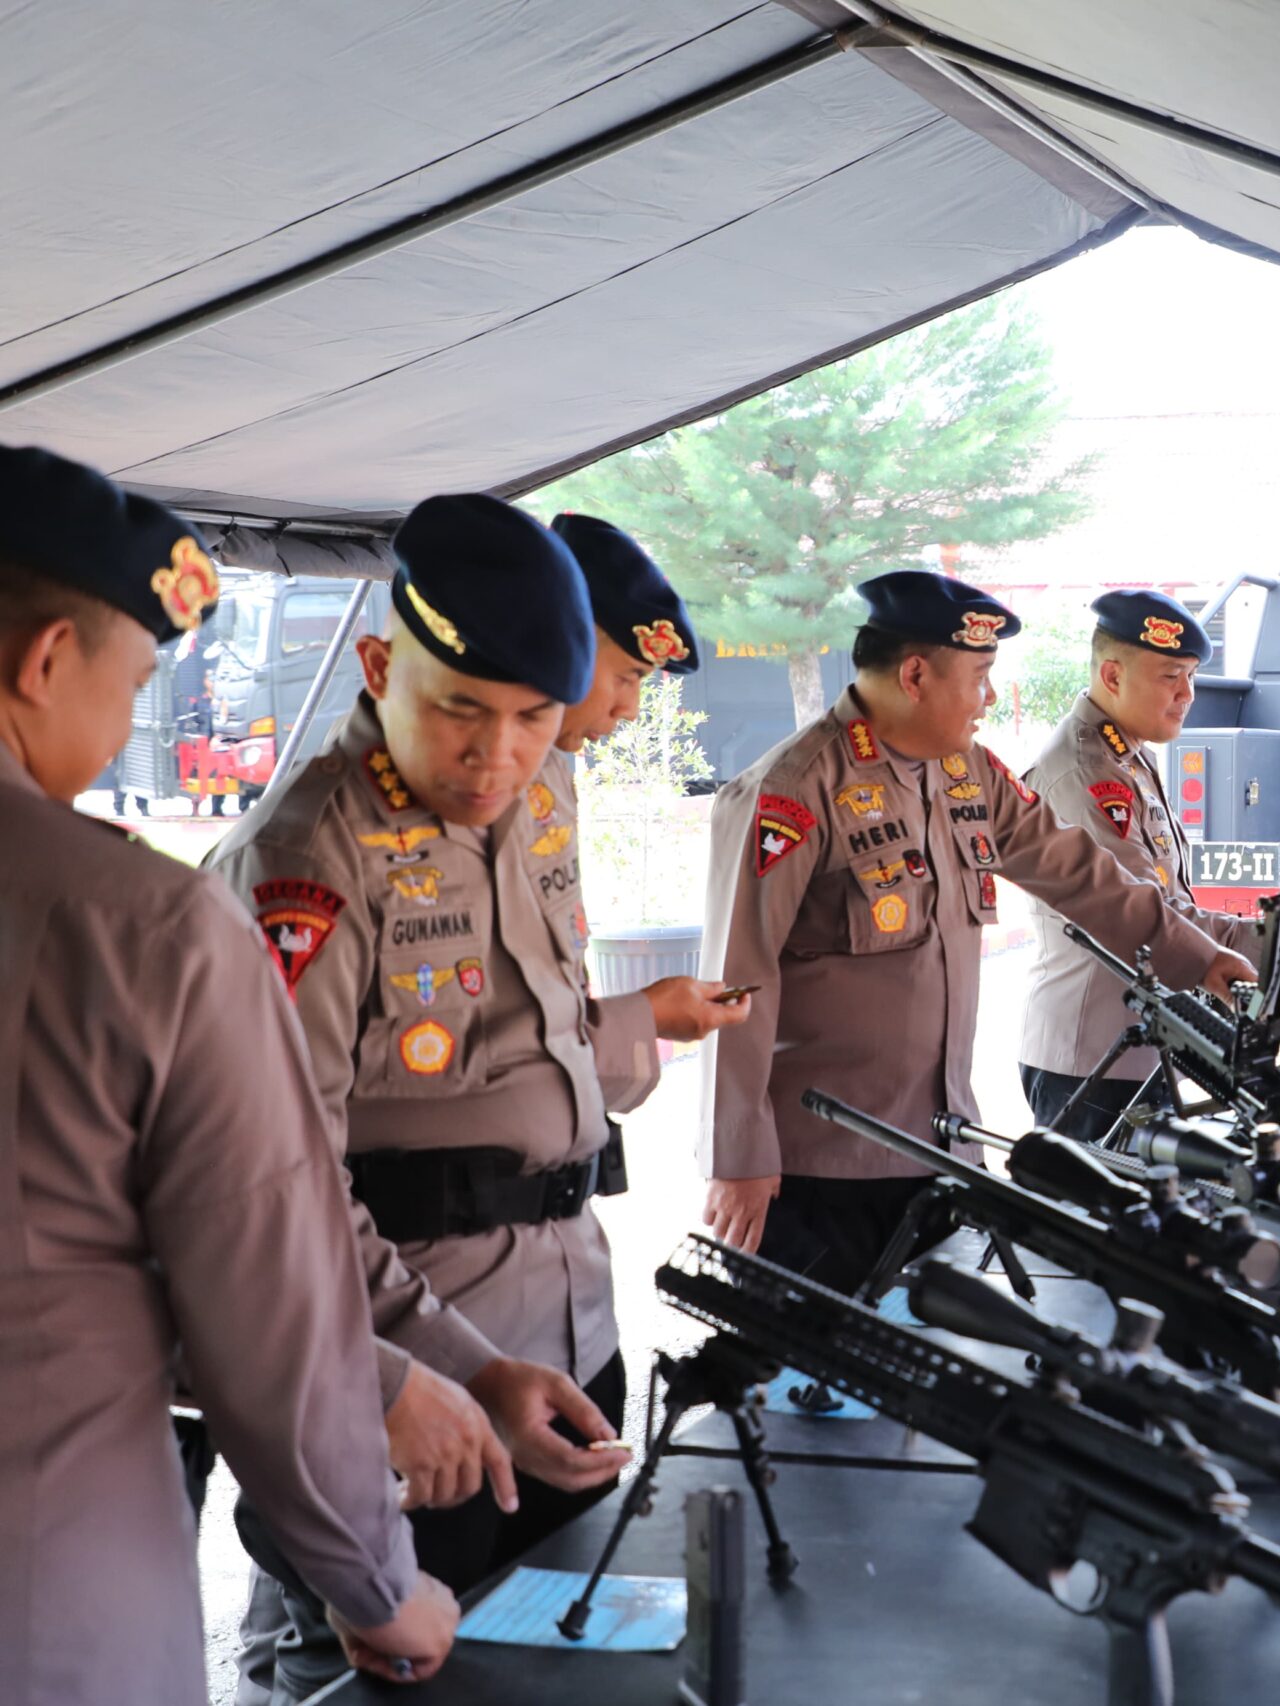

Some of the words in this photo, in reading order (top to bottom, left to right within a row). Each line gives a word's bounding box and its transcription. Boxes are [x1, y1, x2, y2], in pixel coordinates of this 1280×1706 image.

[849, 818, 908, 854] HERI
[1200, 852, 1275, 881] 173-II
[393, 911, 473, 945] GUNAWAN
